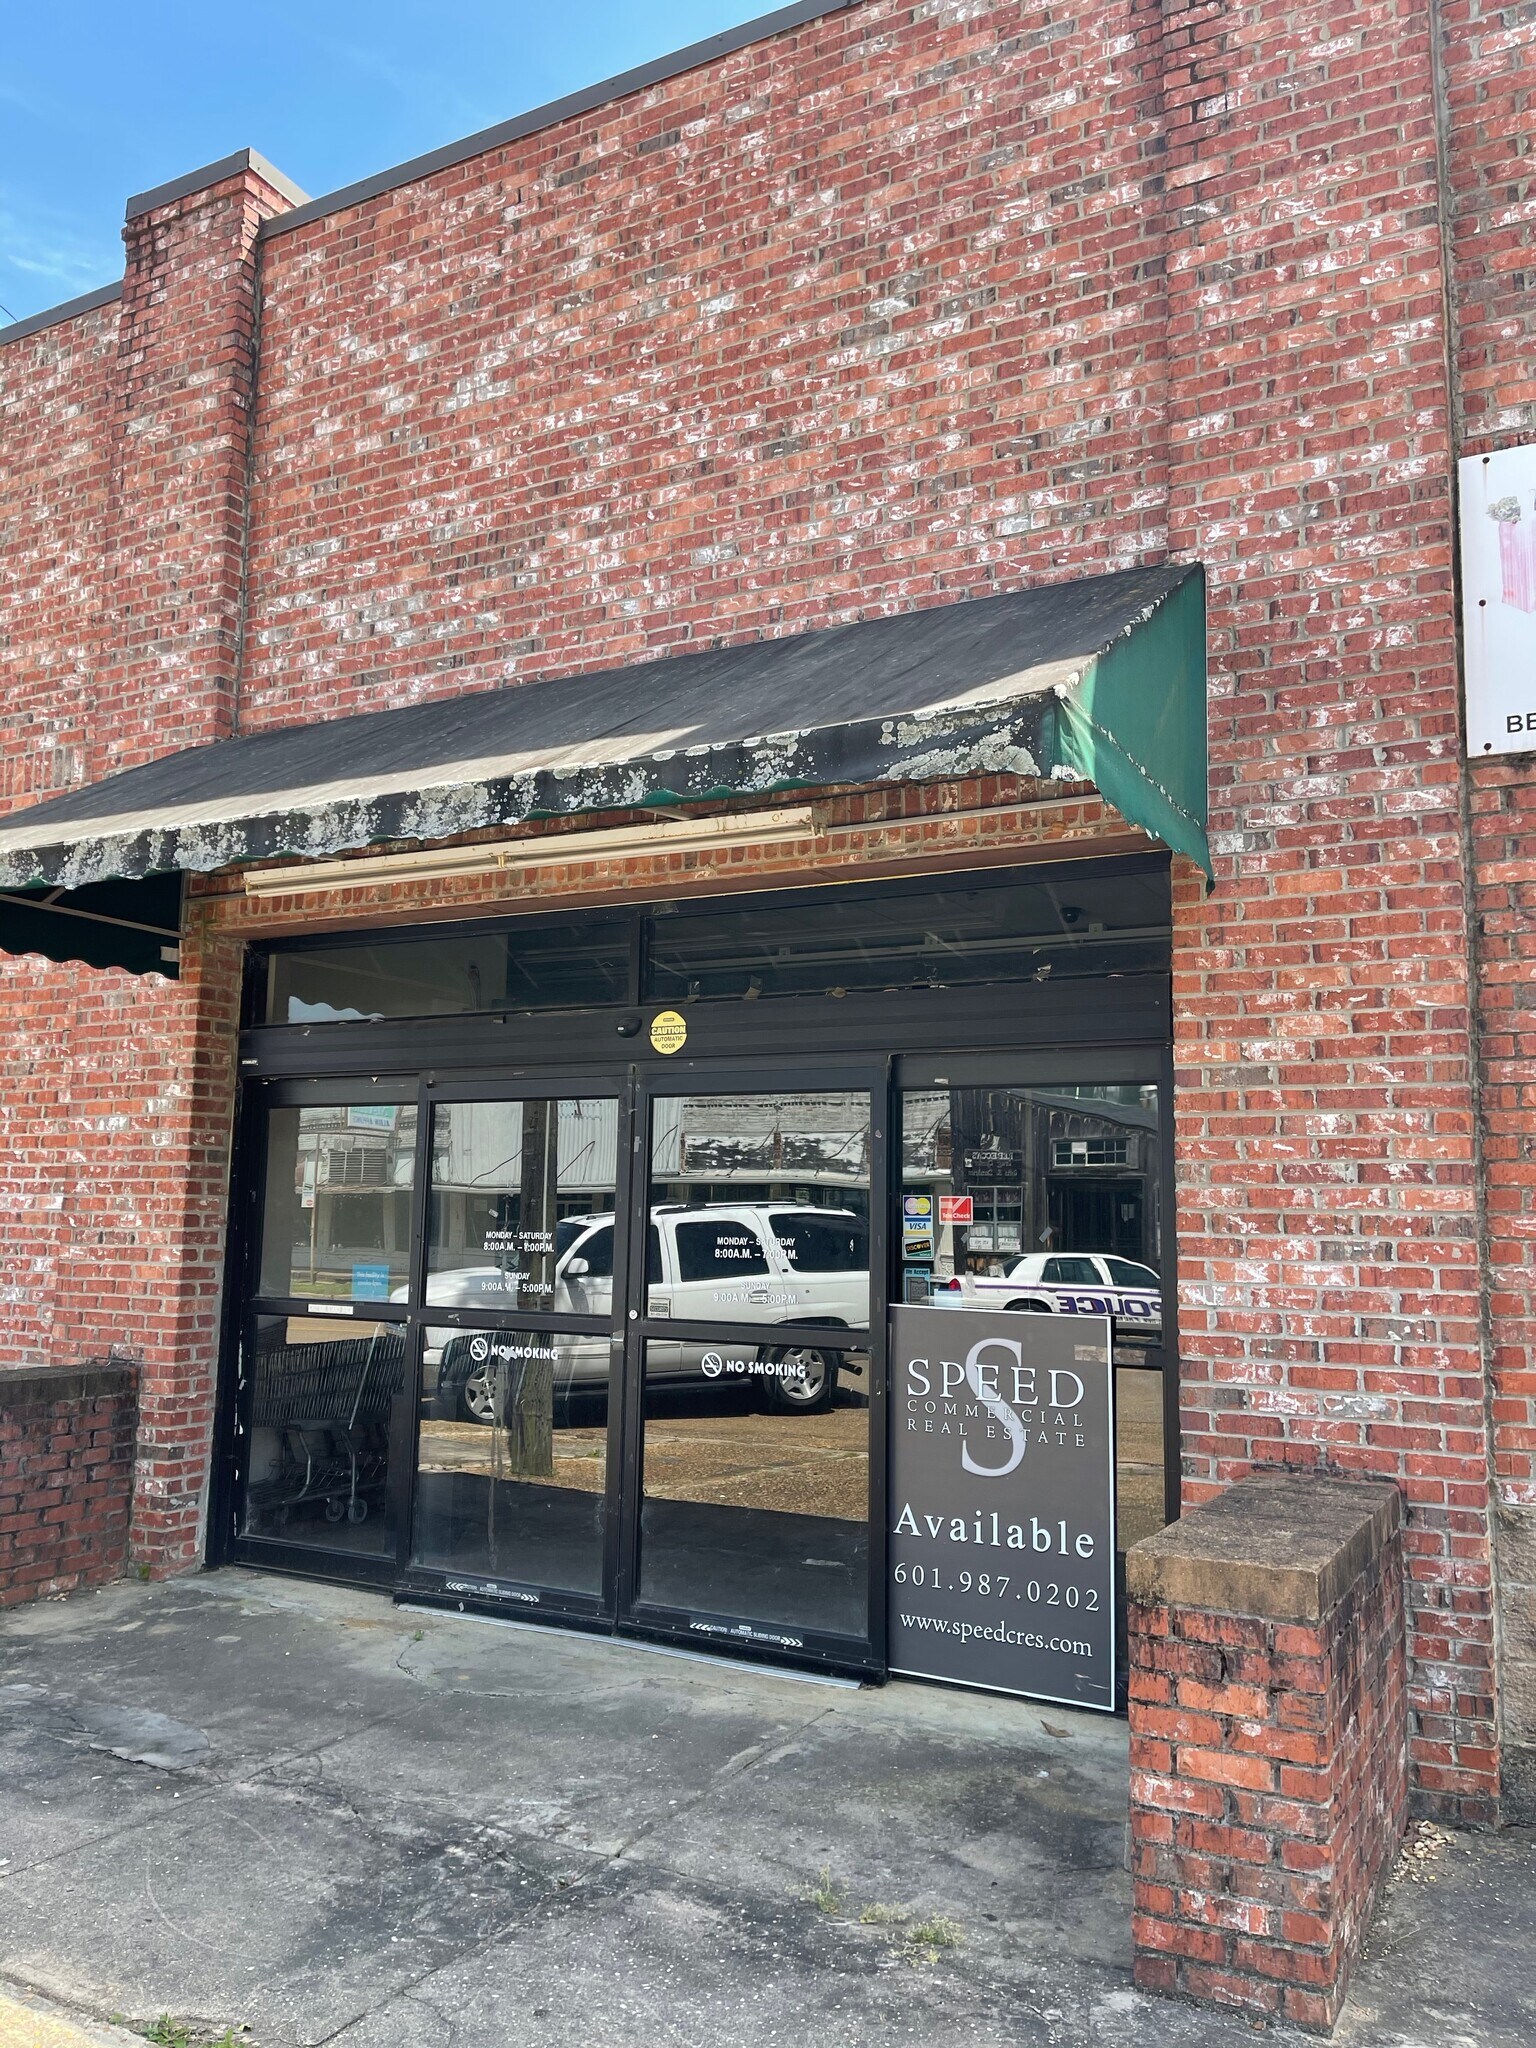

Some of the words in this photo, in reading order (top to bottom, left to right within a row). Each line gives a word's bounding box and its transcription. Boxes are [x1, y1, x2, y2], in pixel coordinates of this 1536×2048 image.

[651, 1026, 686, 1035] CAUTION
[909, 1222, 927, 1230] VISA
[485, 1231, 512, 1239] MONDAY
[518, 1232, 553, 1240] SATURDAY
[483, 1242, 516, 1251] 8:00A.M.
[716, 1236, 749, 1245] MONDAY
[755, 1237, 796, 1247] SATURDAY
[906, 1241, 930, 1252] DISCOVER
[714, 1248, 752, 1259] 8:00A.M.
[504, 1272, 530, 1280] SUNDAY
[740, 1281, 771, 1290] SUNDAY
[491, 1345, 506, 1357] NO
[726, 1360, 745, 1373] NO
[748, 1362, 806, 1378] SMOKING
[907, 1358, 1085, 1408] SPEED
[907, 1399, 1084, 1428] COMMERCIAL
[907, 1418, 968, 1437] REAL
[986, 1424, 1086, 1448] ESTATE
[893, 1502, 1095, 1559] Available
[894, 1562, 1100, 1613] 601.987.0202
[900, 1612, 1093, 1658] www.speedcres.com
